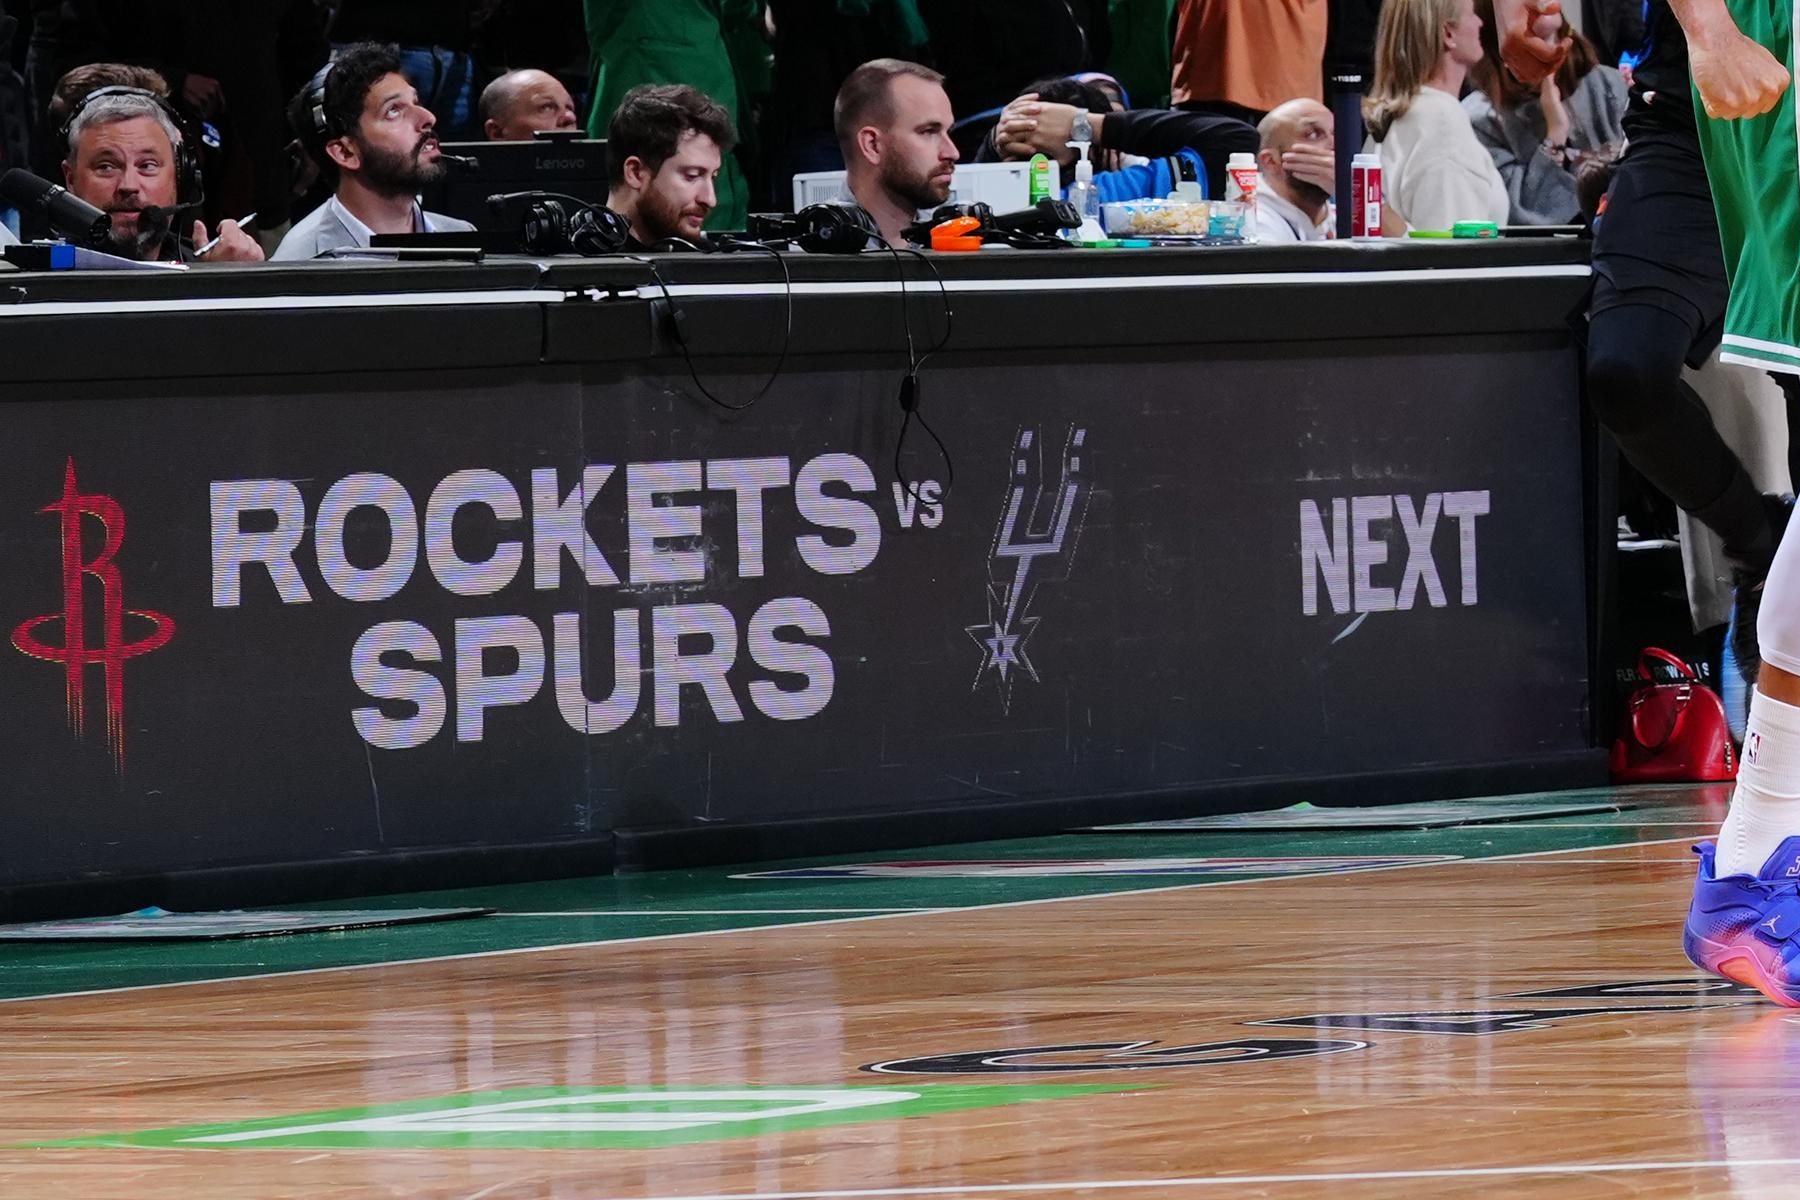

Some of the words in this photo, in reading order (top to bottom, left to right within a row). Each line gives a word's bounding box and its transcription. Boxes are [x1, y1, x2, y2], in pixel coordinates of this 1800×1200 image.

[535, 156, 585, 170] Lenovo
[210, 452, 882, 607] ROCKETS
[892, 480, 944, 530] VS
[1299, 489, 1491, 616] NEXT
[351, 597, 834, 750] SPURS
